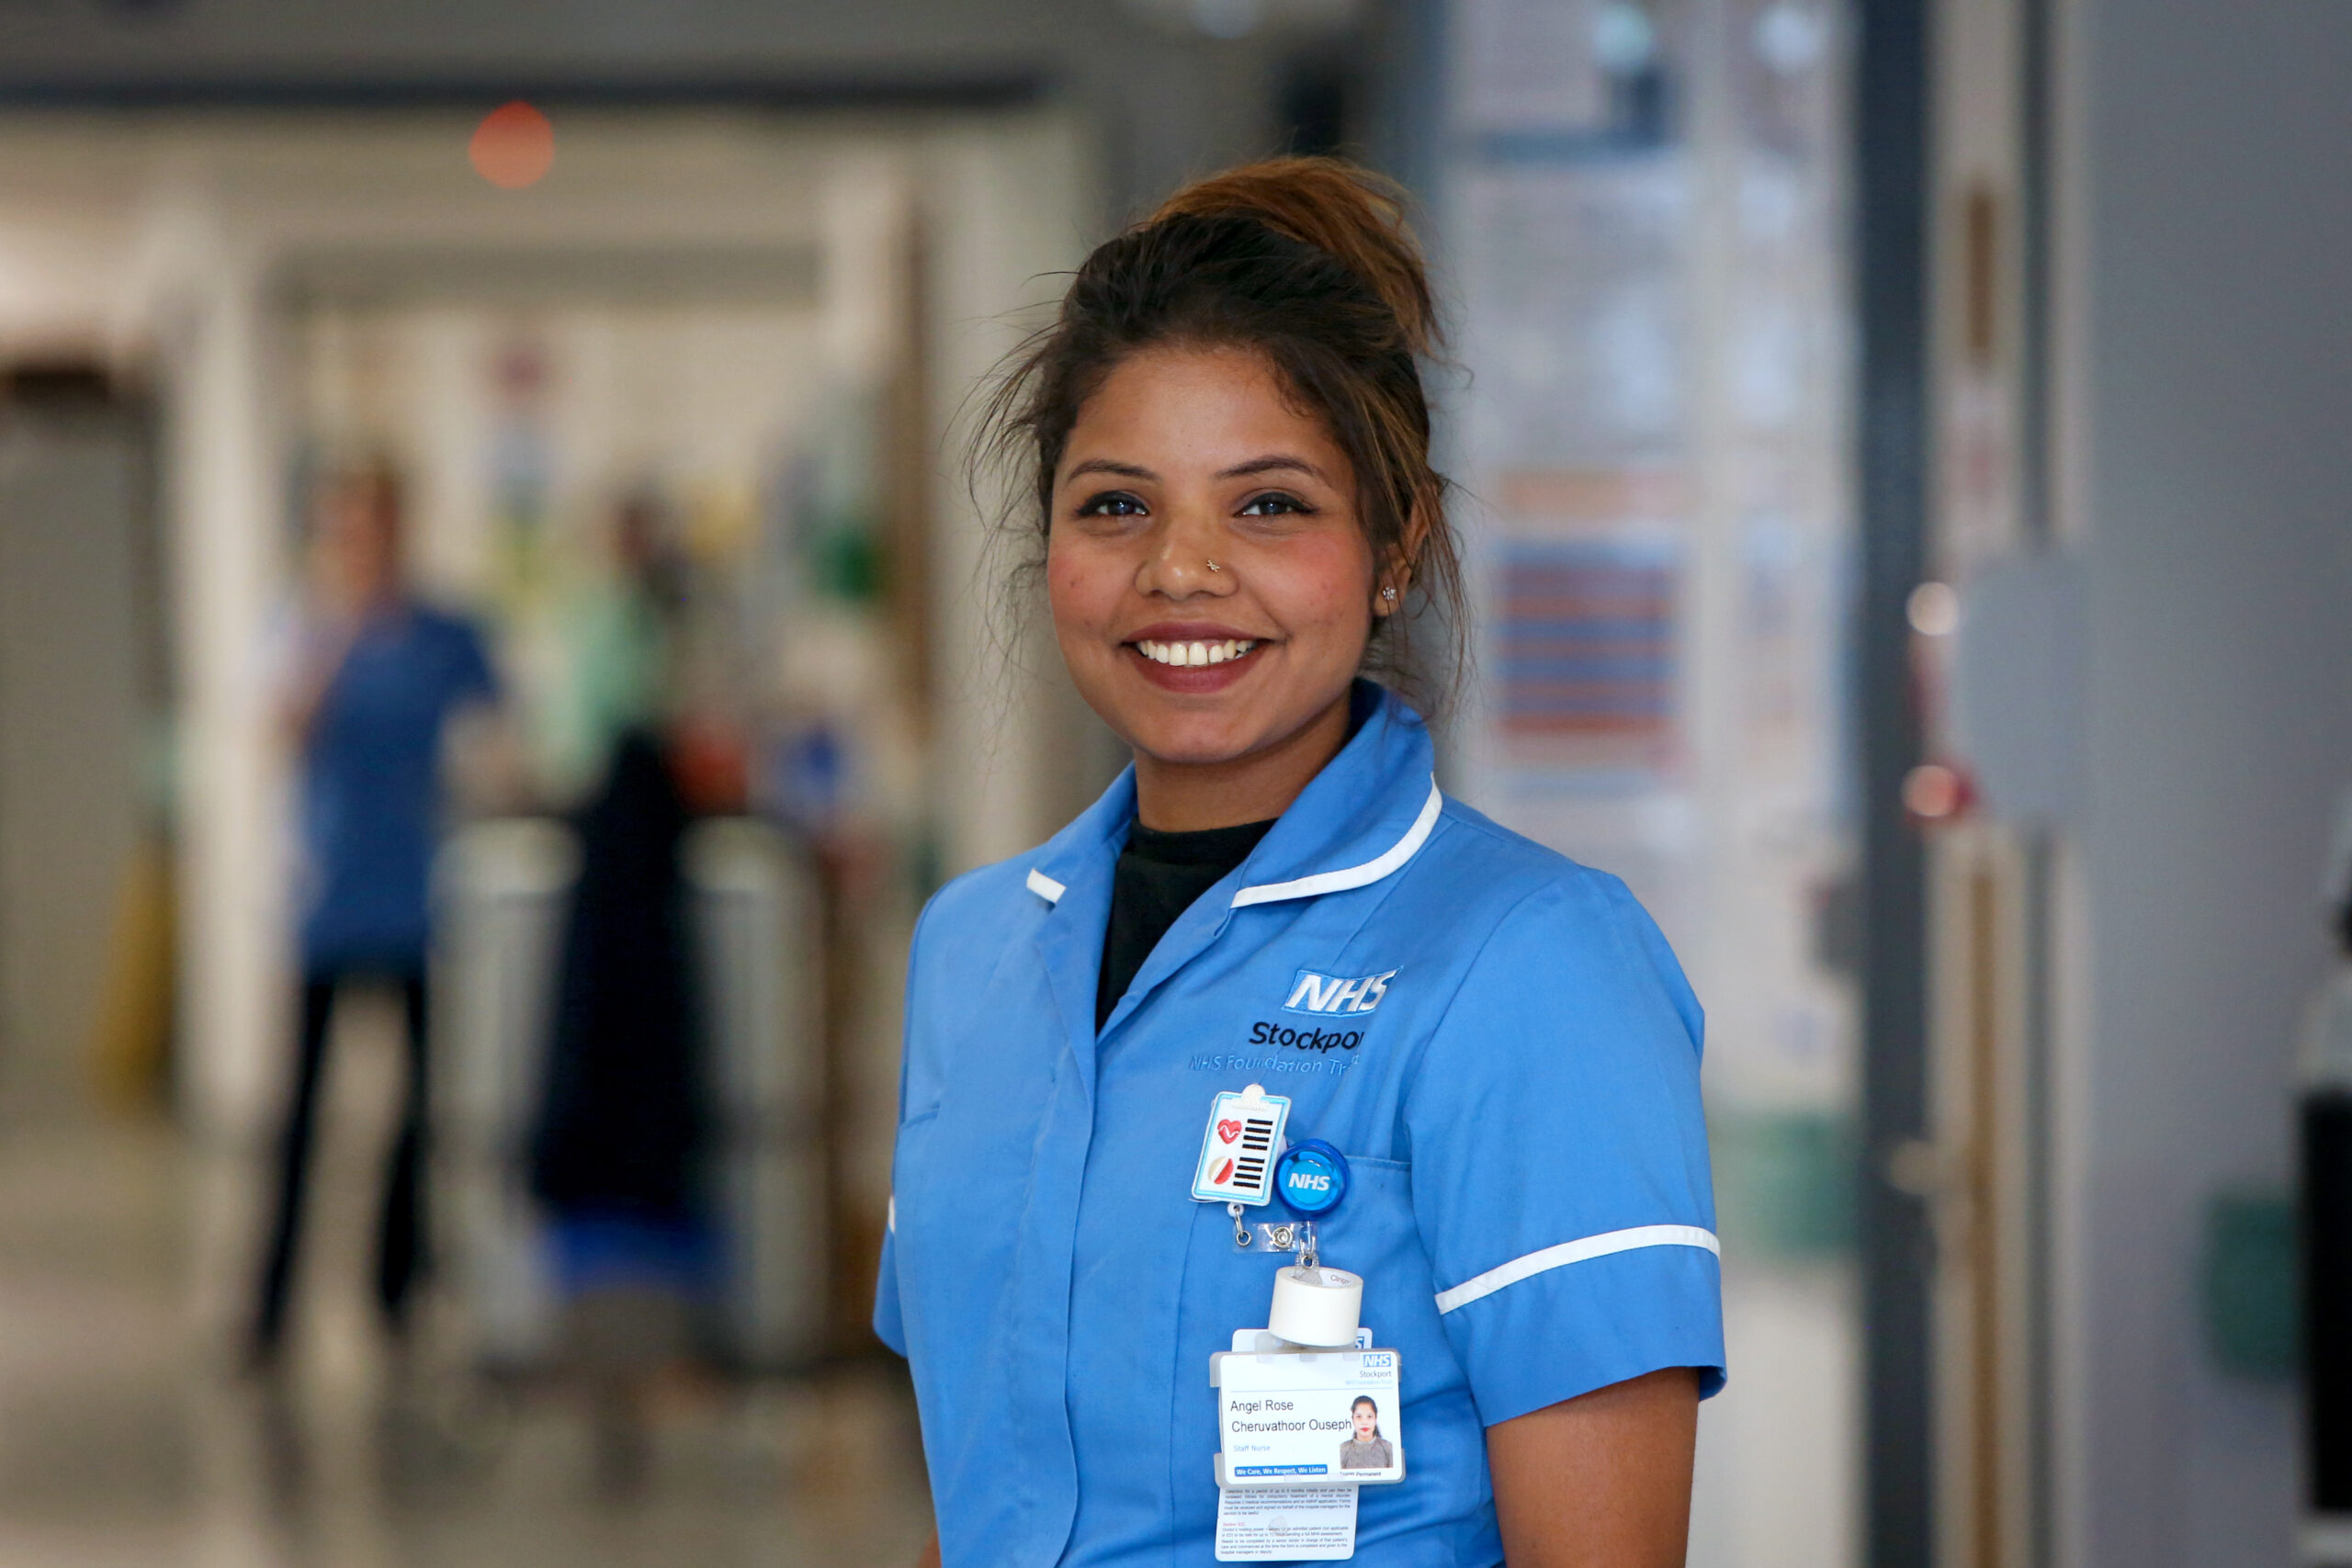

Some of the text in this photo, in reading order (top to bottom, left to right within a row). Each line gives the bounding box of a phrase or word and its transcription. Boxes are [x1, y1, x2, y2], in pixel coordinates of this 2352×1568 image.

[1285, 968, 1399, 1012] NHS
[1250, 1021, 1364, 1054] Stockpo
[1189, 1055, 1221, 1071] NHS
[1226, 1055, 1322, 1073] Foundation
[1288, 1172, 1330, 1190] NHS
[1363, 1354, 1391, 1367] NHS
[1359, 1370, 1392, 1379] Stockport
[1230, 1399, 1294, 1414] Angel Rose
[1232, 1418, 1352, 1433] Cheruvathoor Ouseph
[1251, 1444, 1271, 1452] Nurse
